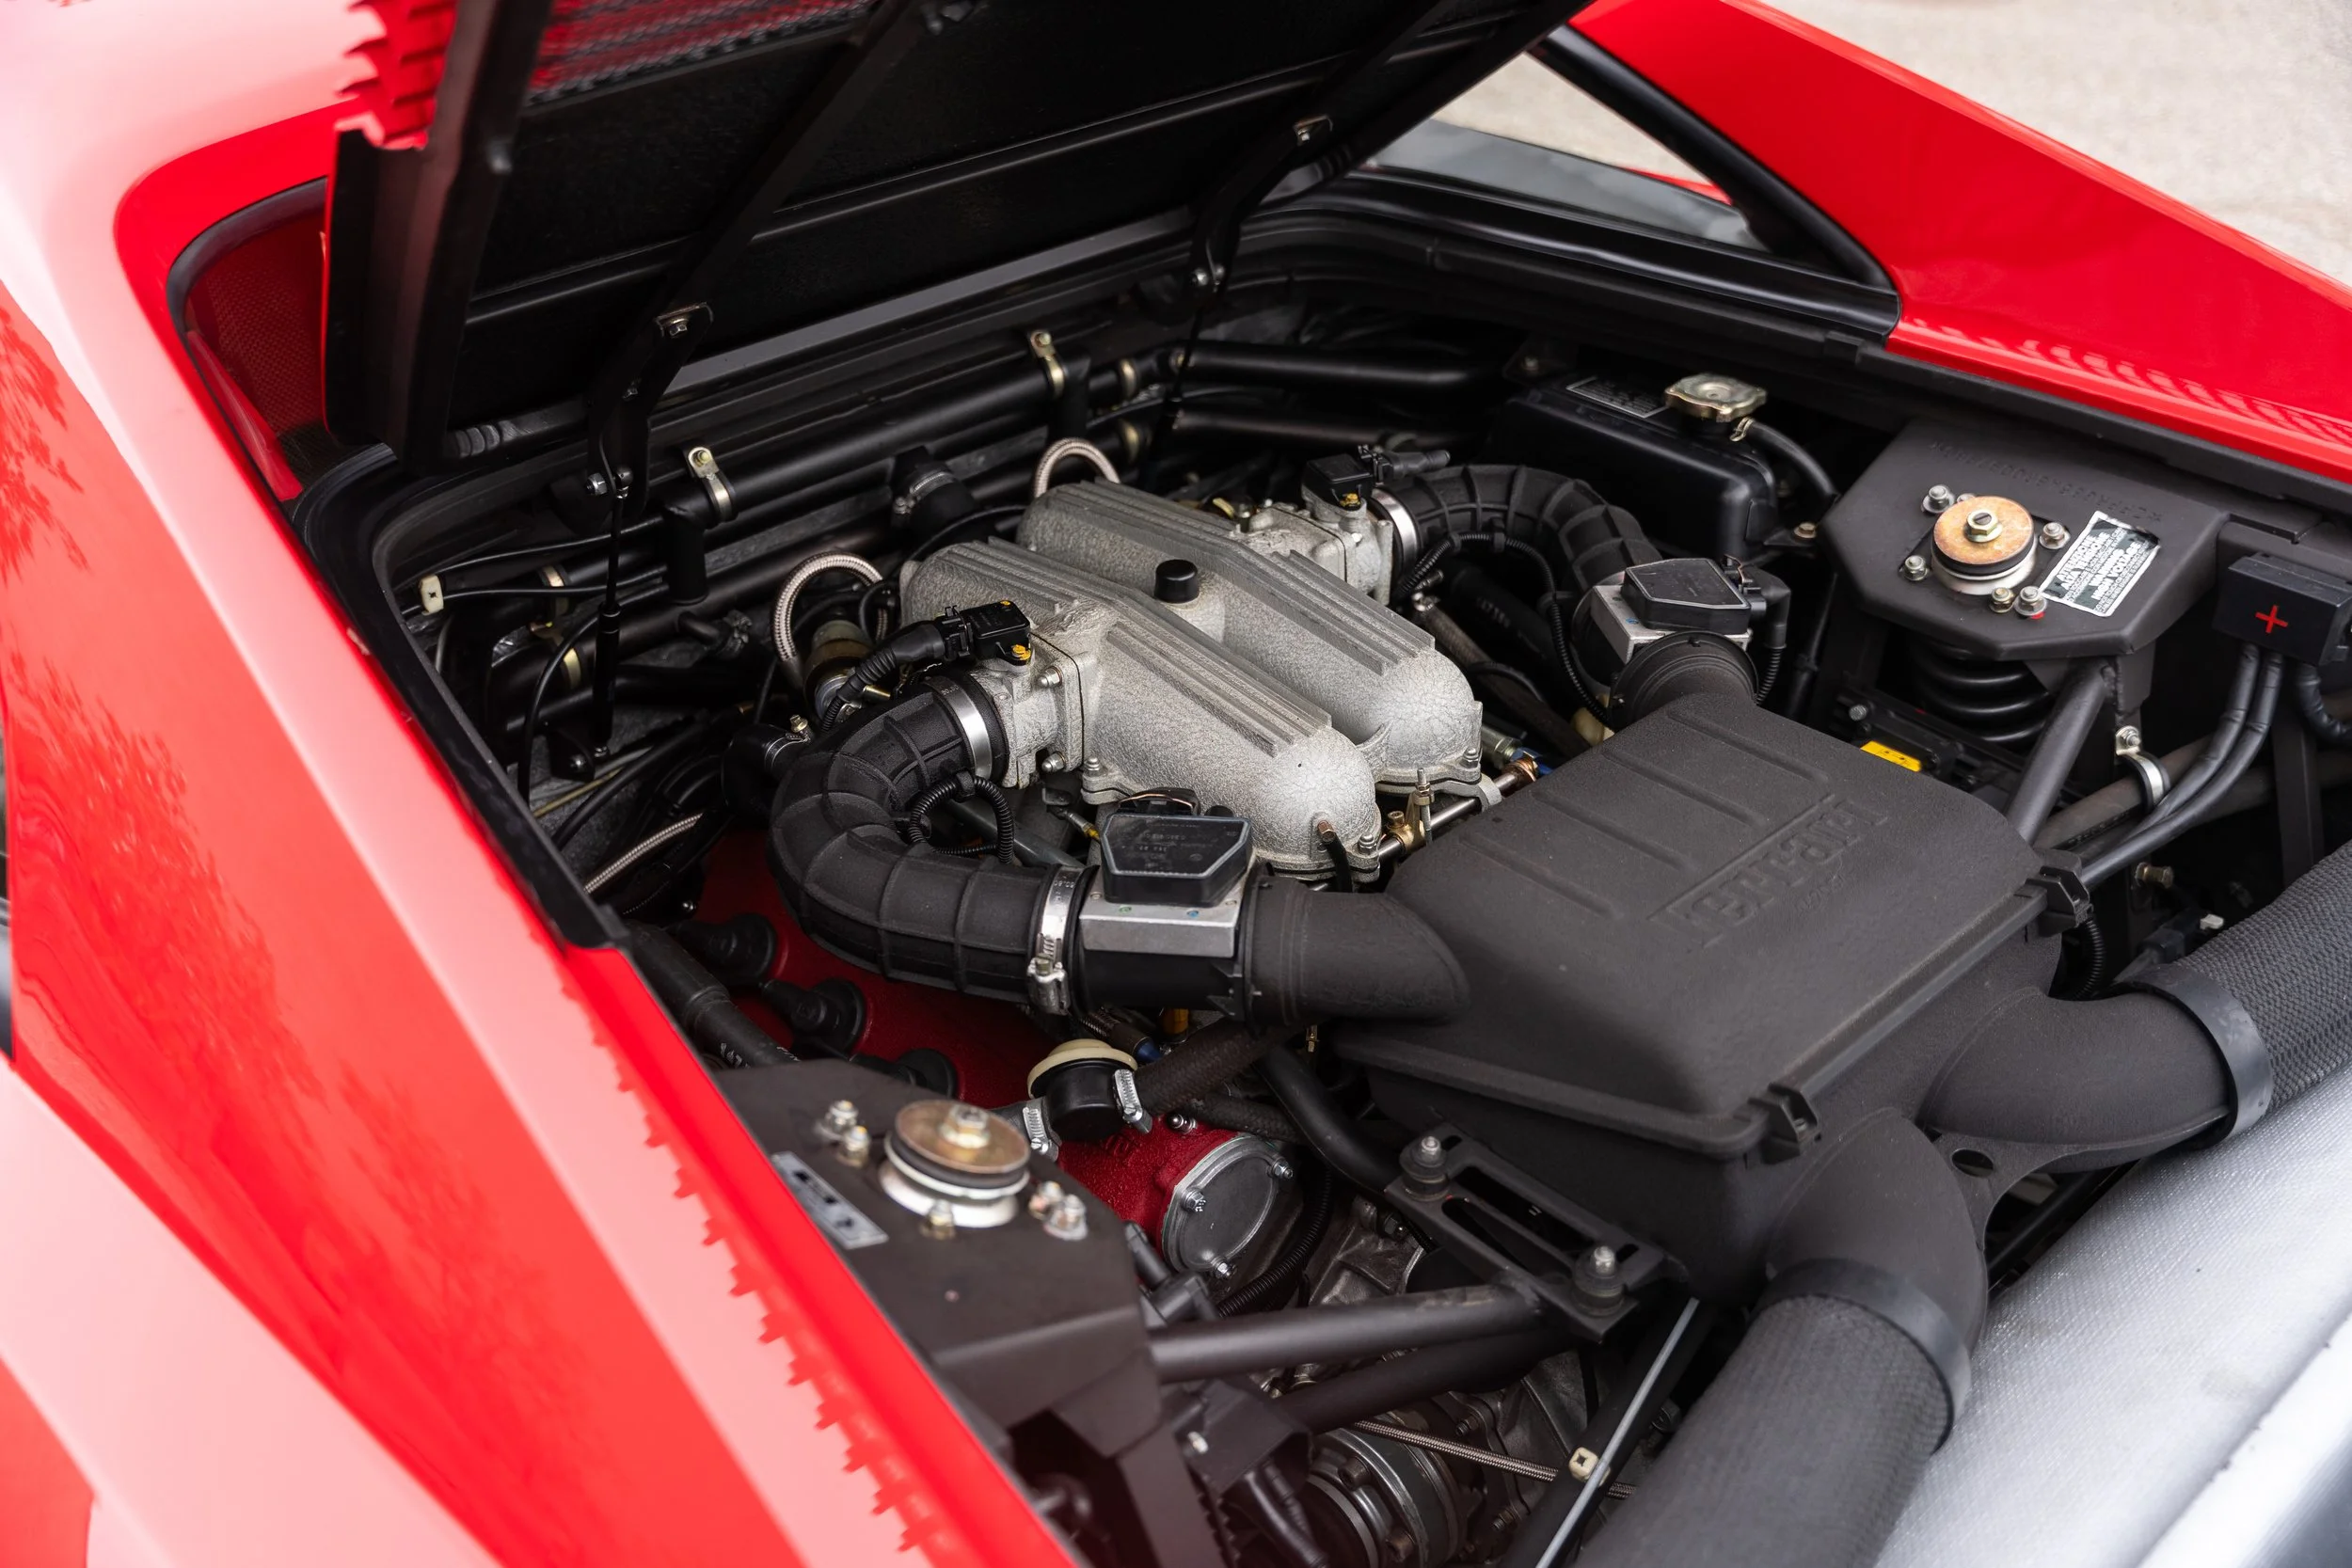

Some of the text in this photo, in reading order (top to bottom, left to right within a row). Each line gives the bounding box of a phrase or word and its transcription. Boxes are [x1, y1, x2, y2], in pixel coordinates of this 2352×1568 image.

[2054, 532, 2096, 581] ATTENZIONE
[2058, 530, 2110, 590] ALTA TENSIONE
[2087, 546, 2125, 587] WARNING
[2090, 540, 2142, 600] HIGH VOLTAGE
